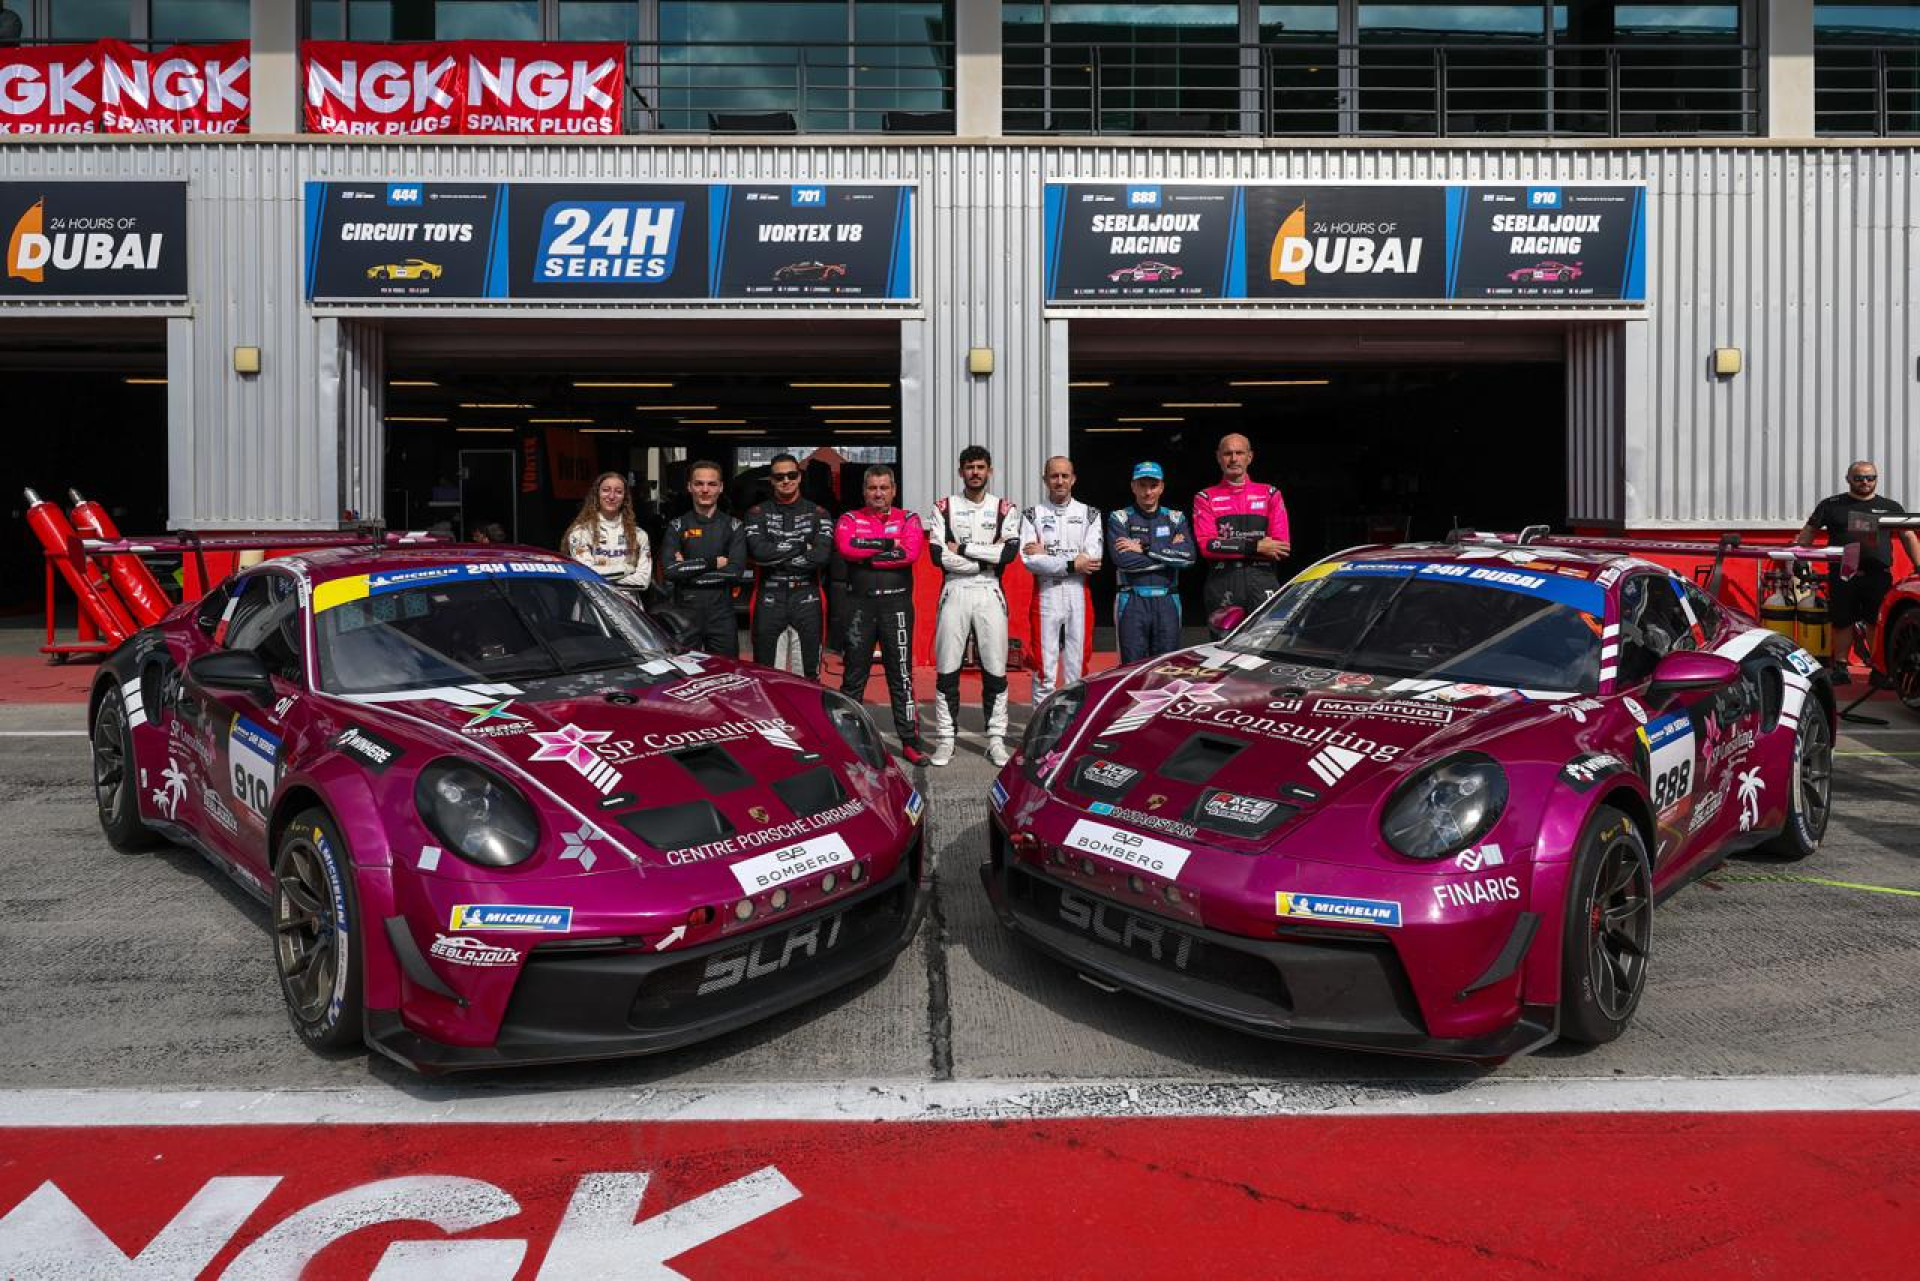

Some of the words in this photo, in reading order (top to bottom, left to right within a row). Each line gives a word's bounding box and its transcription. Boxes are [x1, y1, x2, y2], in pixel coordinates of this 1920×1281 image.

[102, 53, 250, 113] NGK
[308, 55, 456, 114] NGK
[467, 54, 617, 111] NGK
[318, 114, 379, 136] PARK
[385, 115, 452, 136] PLUGS
[467, 114, 535, 133] SPARK
[540, 116, 613, 134] PLUGS
[392, 189, 419, 201] 444
[796, 190, 821, 204] 701
[1533, 191, 1557, 205] 910
[50, 218, 65, 229] 24
[69, 218, 115, 229] HOURS
[117, 218, 137, 229] OF
[341, 223, 420, 242] CIRCUIT
[423, 223, 474, 242] TOYS
[548, 208, 676, 256] 24H
[1091, 213, 1202, 232] SEBLAJOUX
[1313, 222, 1328, 235] 24
[1331, 222, 1372, 235] HOURS
[1375, 222, 1398, 235] OF
[1491, 214, 1602, 233] SEBLAJOUX
[758, 224, 831, 243] VORTEX
[837, 224, 863, 243] V8
[16, 233, 163, 271] DUBAI
[1110, 236, 1183, 255] RACING
[1279, 236, 1423, 274] DUBAI
[1510, 236, 1583, 255] RACING
[544, 257, 666, 278] SERIES
[390, 568, 459, 582] MICHELIN
[466, 562, 507, 575] 24H
[509, 562, 568, 575] DUBAI
[1419, 563, 1471, 577] 24H
[1467, 567, 1547, 590] DUBAI
[1322, 701, 1445, 719] MAGNITUDE
[595, 739, 635, 762] SP
[643, 717, 796, 749] Consulting
[1166, 701, 1213, 717] SP
[1213, 708, 1405, 763] Consulting
[234, 762, 270, 819] 910
[1654, 758, 1692, 809] 888
[666, 838, 739, 867] CENTRE
[738, 818, 811, 852] PORSCHE
[808, 798, 866, 830] LORRAINE
[1077, 836, 1165, 872] BOMBERG
[756, 850, 842, 888] BOMBERG
[1433, 875, 1521, 910] FINARIS
[485, 912, 562, 926] MICHELIN
[1313, 902, 1392, 919] MICHELIN
[429, 943, 523, 963] SEBLAJOUX
[0, 1164, 804, 1281] NGK
